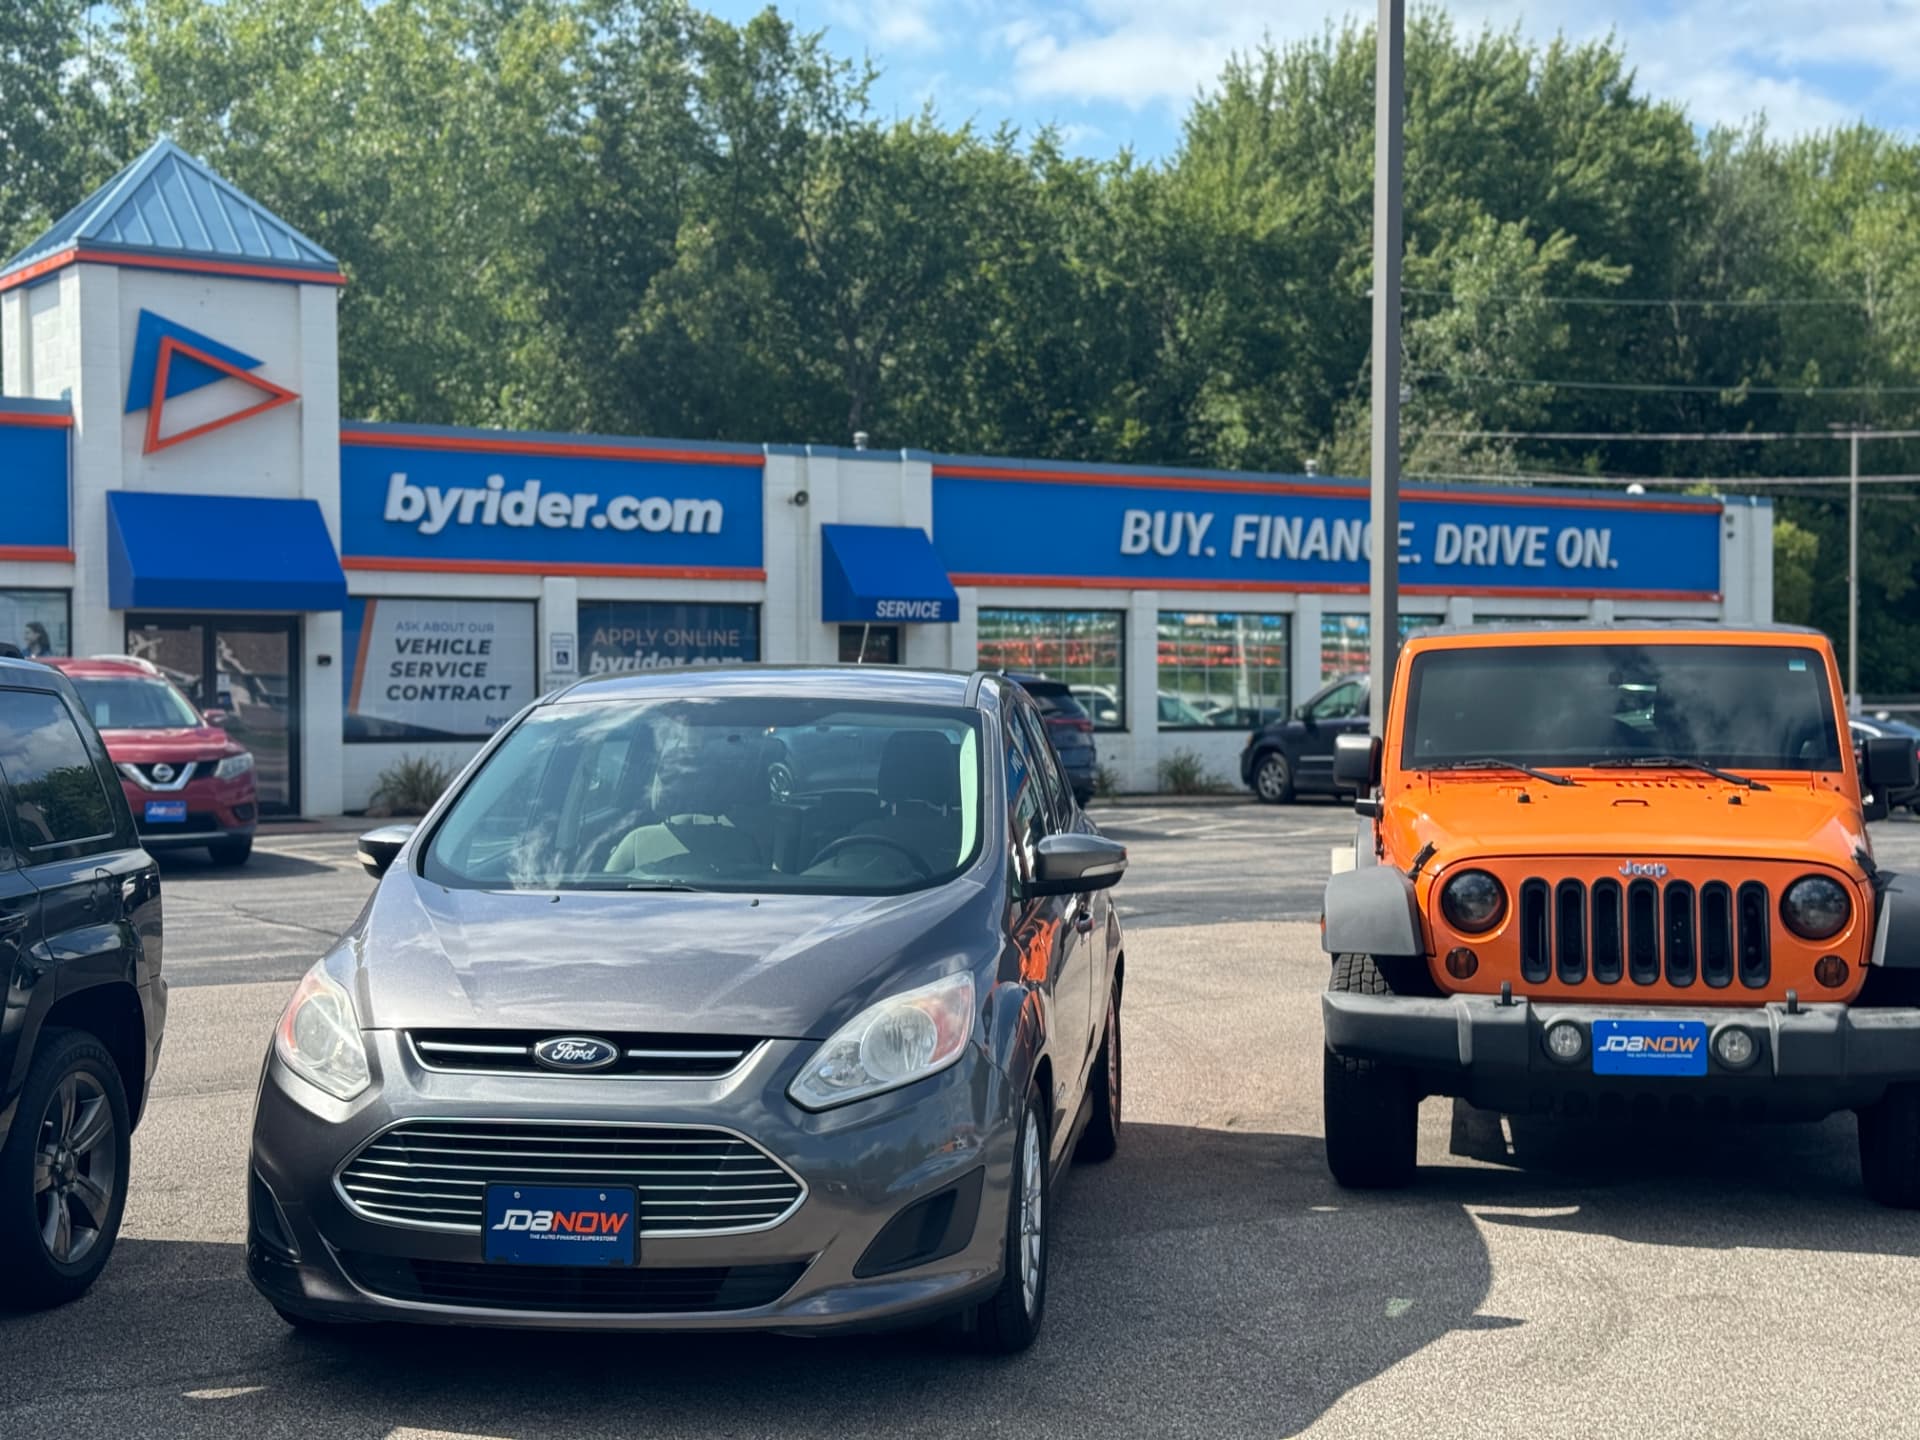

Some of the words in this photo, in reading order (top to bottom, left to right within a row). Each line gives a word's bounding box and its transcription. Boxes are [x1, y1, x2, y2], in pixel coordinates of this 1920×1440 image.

[384, 472, 723, 535] byrider.com
[1120, 509, 1216, 557] BUY.
[1434, 522, 1550, 568] DRIVE
[1556, 527, 1619, 570] ON.
[876, 600, 942, 619] SERVICE
[395, 621, 420, 632] ASK
[423, 622, 465, 633] ABOUT
[467, 622, 495, 633] OUR
[395, 638, 492, 655] VEHICLE
[592, 628, 659, 647] APPLY
[663, 629, 740, 648] ONLINE
[389, 661, 488, 678] SERVICE
[386, 684, 512, 701] CONTRACT
[1618, 859, 1668, 879] Jeep
[551, 1041, 597, 1061] Ford
[491, 1209, 629, 1234] JDBNOW
